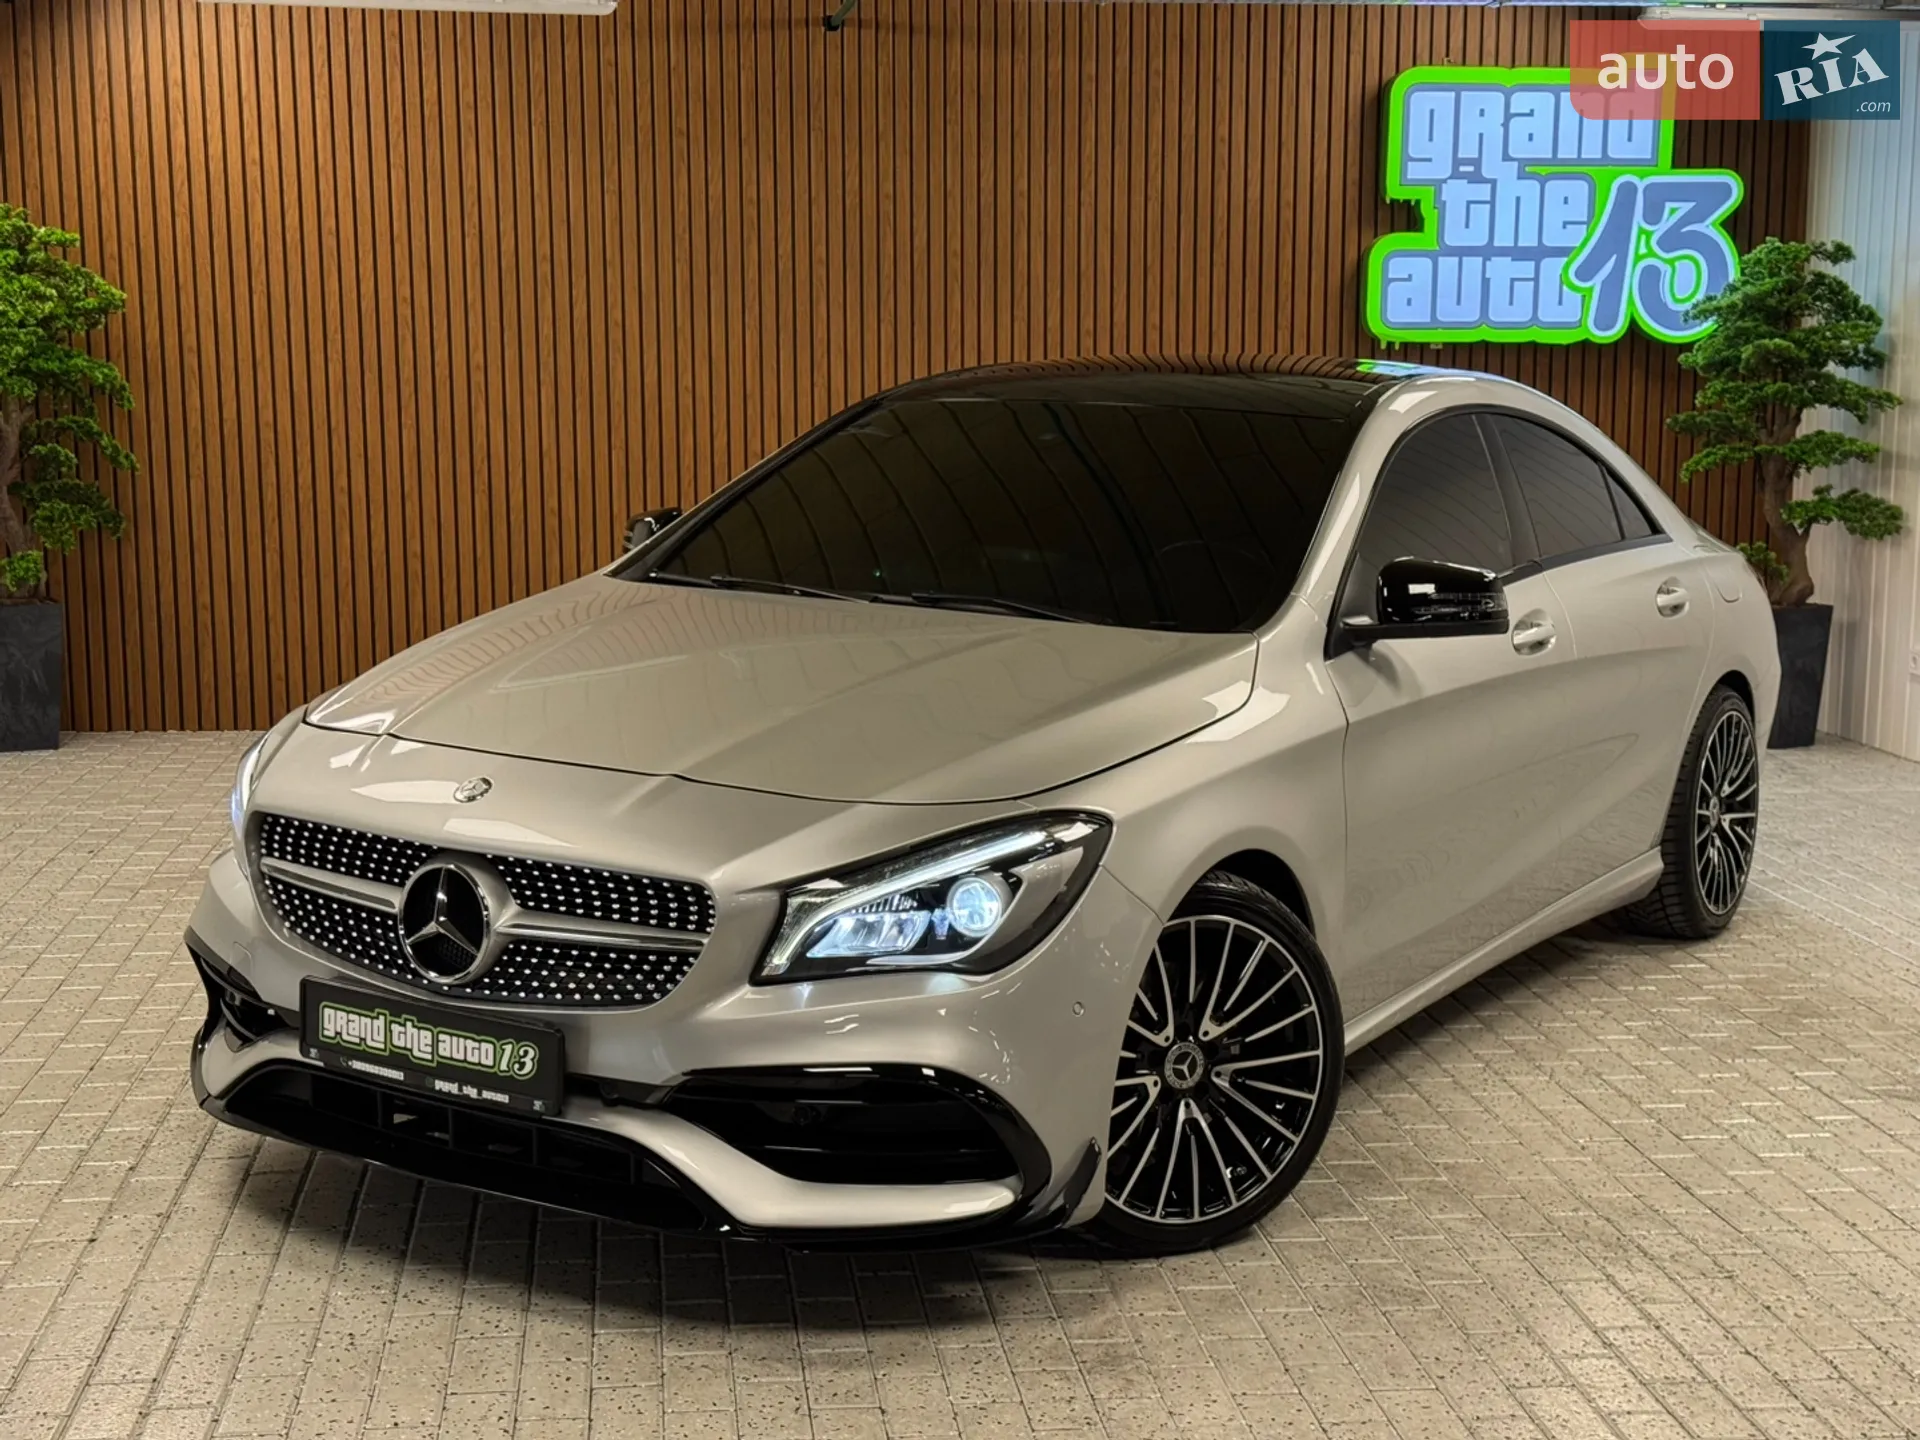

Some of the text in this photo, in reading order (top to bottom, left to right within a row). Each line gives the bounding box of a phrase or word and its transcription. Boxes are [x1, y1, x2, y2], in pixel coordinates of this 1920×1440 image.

[1440, 161, 1591, 248] the
[1386, 173, 1736, 340] auto 13
[391, 1020, 434, 1061] the
[437, 1032, 495, 1067] auto
[498, 1043, 537, 1075] 13
